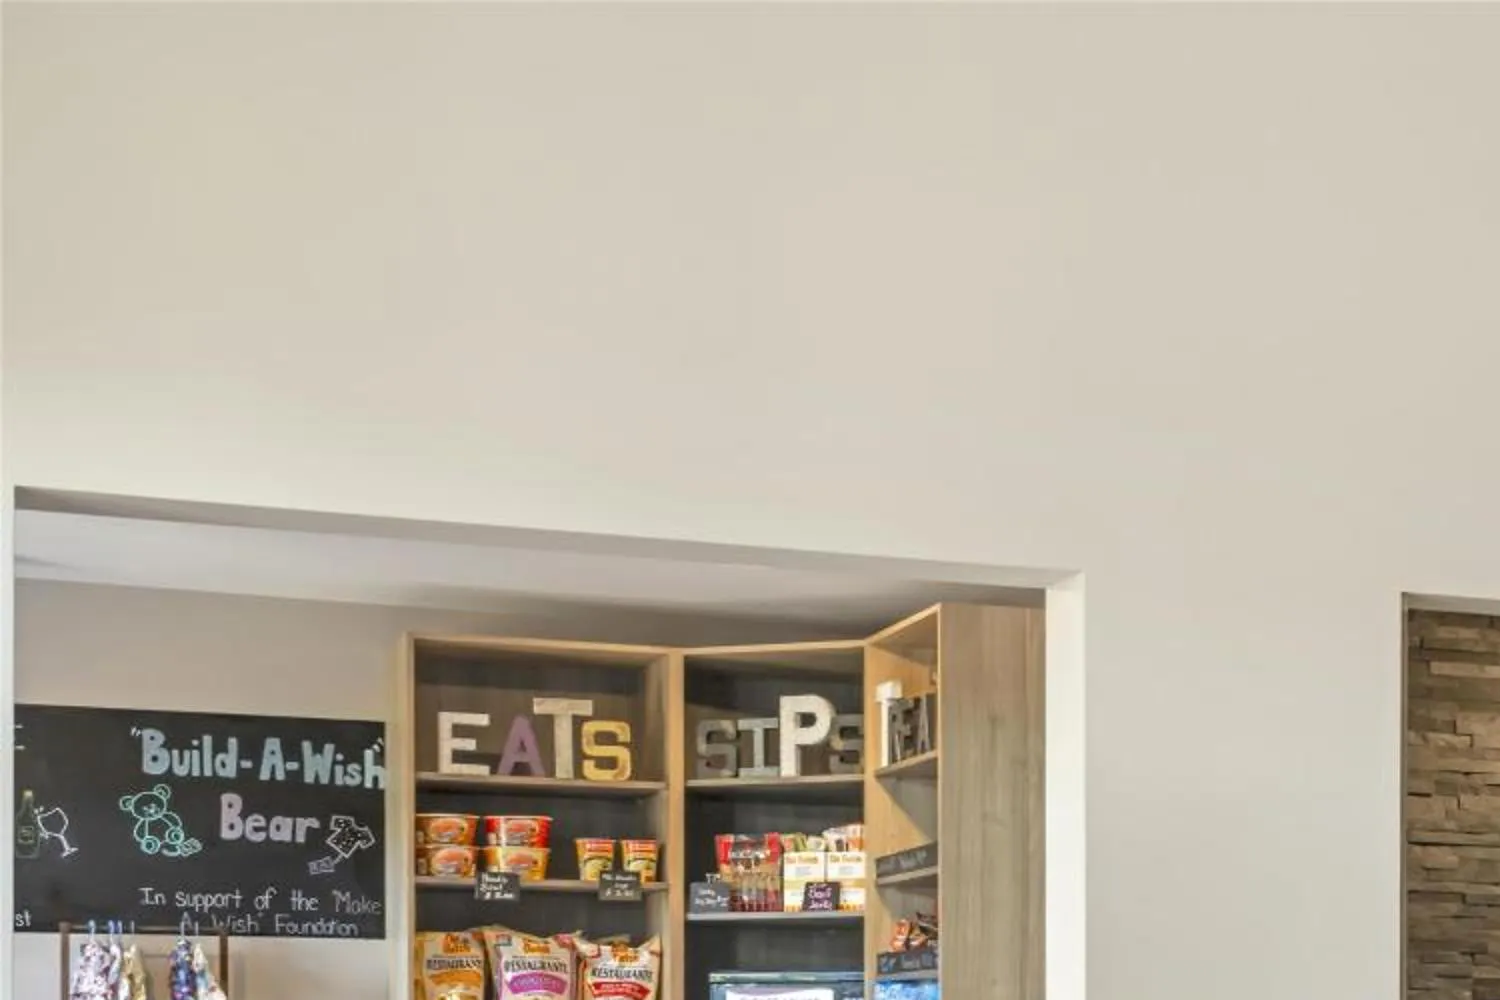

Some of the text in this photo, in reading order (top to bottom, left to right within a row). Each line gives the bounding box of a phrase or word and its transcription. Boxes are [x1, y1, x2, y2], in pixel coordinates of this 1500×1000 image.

[437, 697, 632, 781] EATS
[696, 695, 865, 779] SIPS
[219, 792, 320, 843] Bear
[138, 886, 167, 907] In
[175, 886, 244, 912] support
[254, 886, 276, 911] of
[291, 889, 320, 912] the
[275, 912, 359, 937] Foundation
